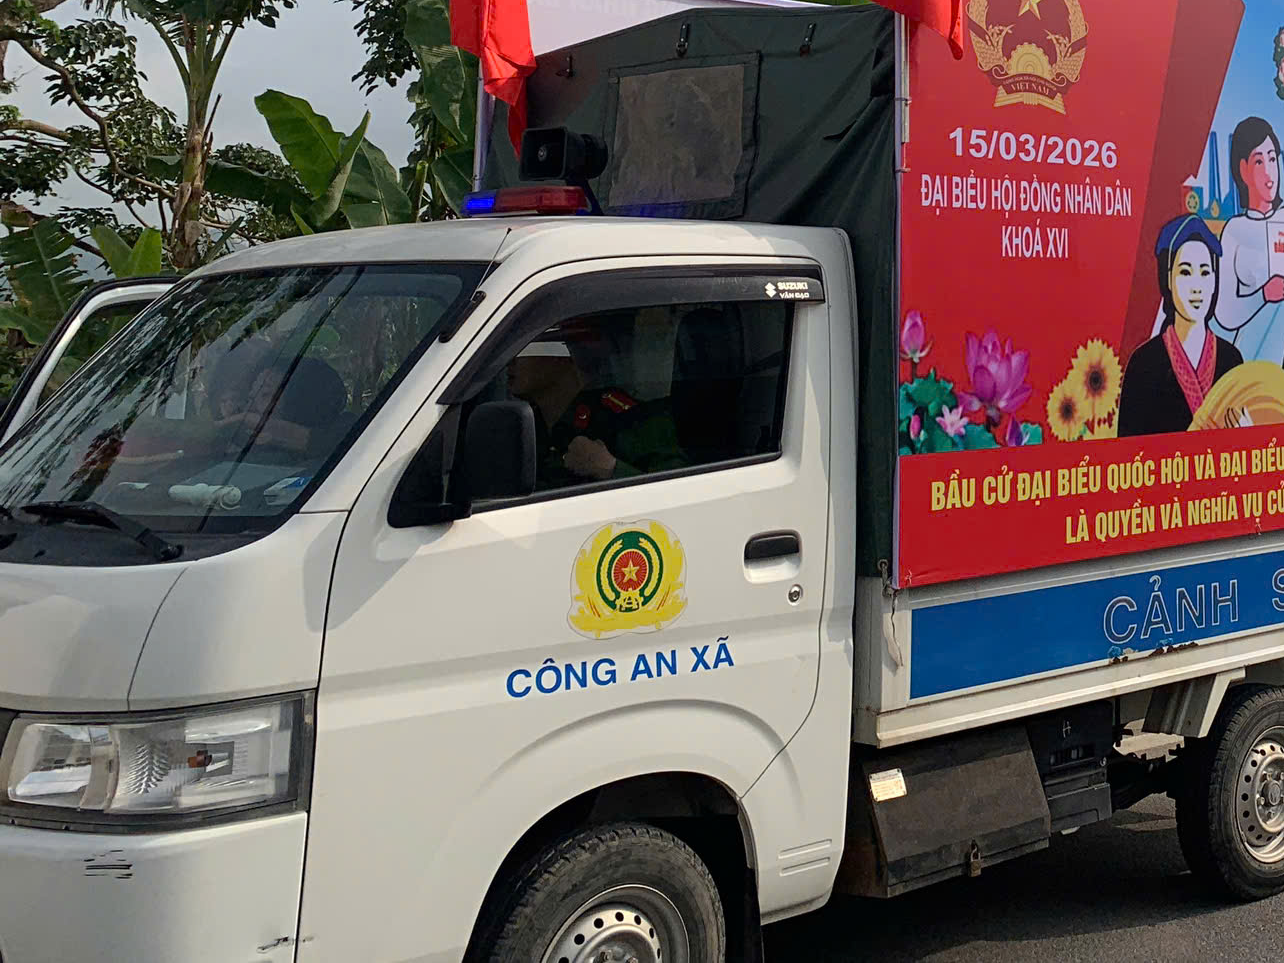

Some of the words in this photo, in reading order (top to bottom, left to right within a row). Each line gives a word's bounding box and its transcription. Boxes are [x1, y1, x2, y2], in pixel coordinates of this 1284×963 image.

[949, 127, 1117, 168] 15/03/2026
[921, 173, 947, 215] ĐẠI
[952, 169, 986, 210] BIỂU
[992, 175, 1016, 218] HỘI
[1020, 174, 1061, 213] ĐỒNG
[1065, 177, 1101, 216] NHÂN
[1105, 179, 1131, 217] DÂN
[1002, 219, 1043, 258] KHOÁ
[1047, 227, 1068, 258] XVI
[777, 281, 808, 290] SUZUKI
[931, 469, 975, 511] BẦU
[983, 465, 1013, 505] CỬ
[1017, 470, 1050, 505] ĐẠI
[1058, 455, 1101, 496] BIỂU
[1107, 452, 1155, 493] QUỐC
[1161, 451, 1189, 488] HỘI
[1194, 449, 1216, 480] VÀ
[1220, 447, 1246, 482] ĐẠI
[1066, 509, 1089, 544] LÀ
[1095, 499, 1155, 542] QUYỀN
[1160, 497, 1183, 530] VÀ
[1187, 491, 1238, 527] NGHĨA
[1242, 491, 1263, 523] VỤ
[1103, 575, 1239, 645] CẢNH
[506, 658, 617, 698] CÔNG
[630, 649, 678, 681] AN
[691, 635, 735, 672] XÃ
